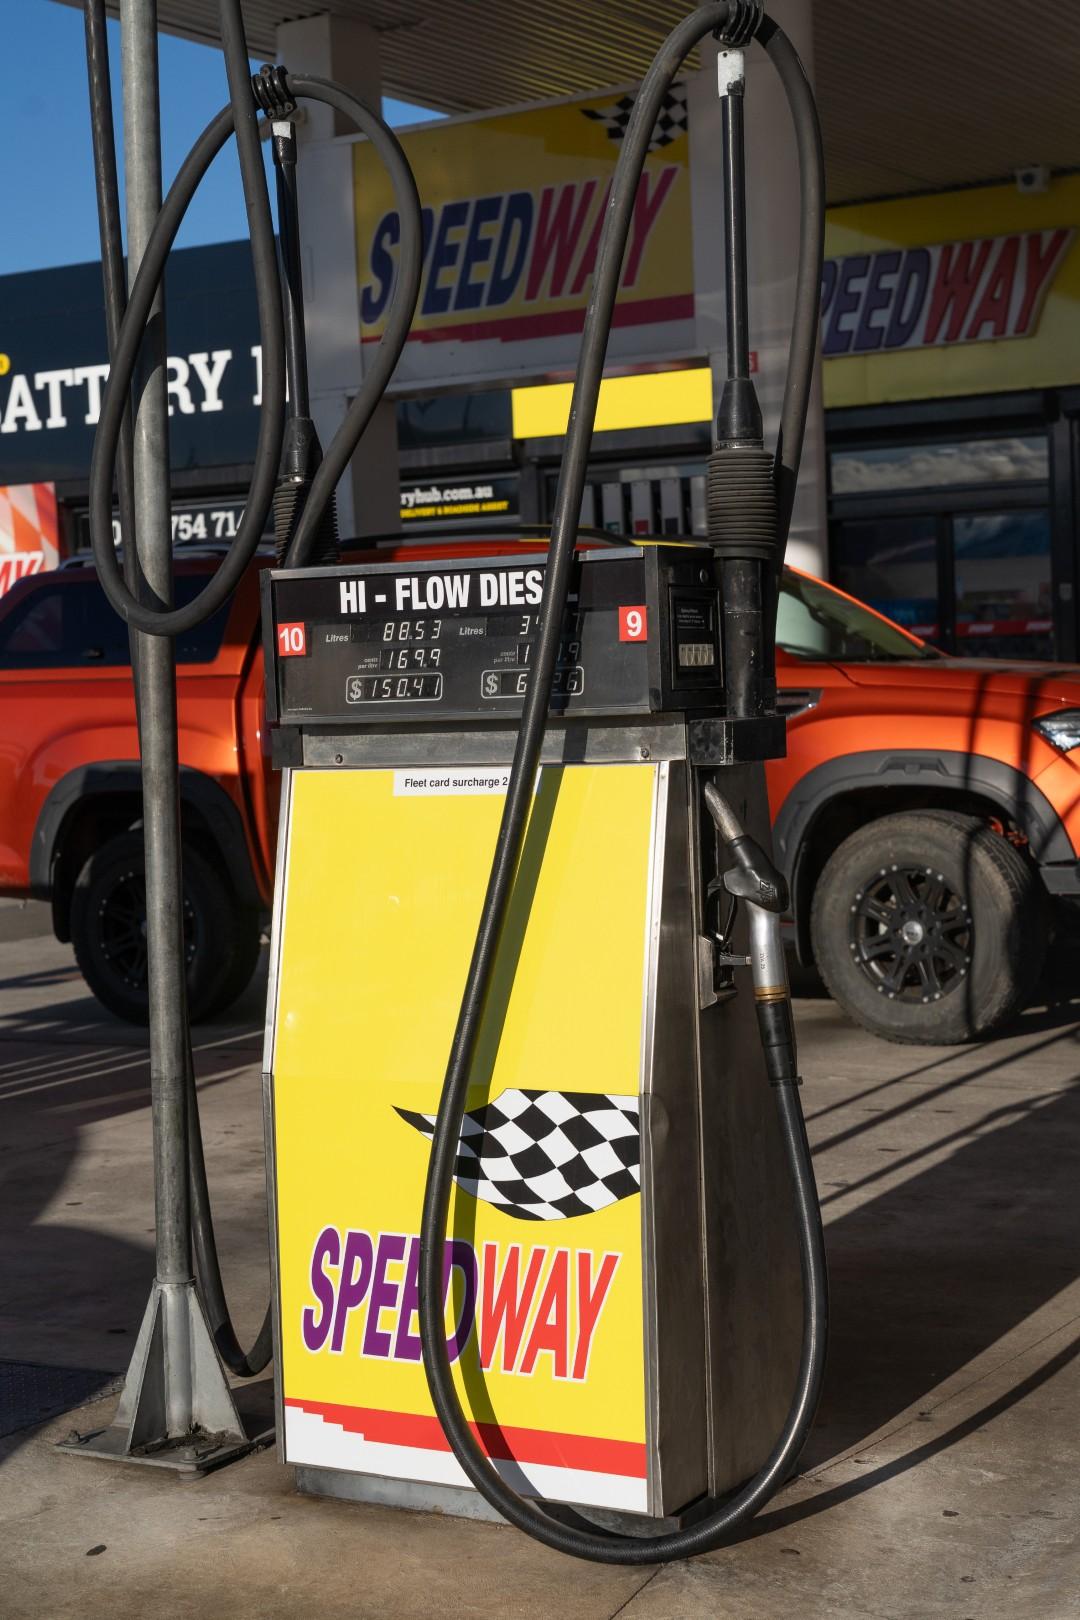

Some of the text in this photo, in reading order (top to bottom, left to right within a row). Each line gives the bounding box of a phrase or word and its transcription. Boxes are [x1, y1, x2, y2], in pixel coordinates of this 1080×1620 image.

[820, 227, 1070, 356] PEEDWAY
[0, 350, 232, 433] ATTRY
[340, 581, 366, 613] HI
[396, 575, 470, 610] FLOW
[480, 570, 546, 607] DIES
[325, 620, 441, 642] Litres 88.53
[459, 627, 484, 636] Litres
[627, 611, 643, 637] 9
[279, 627, 305, 652] 10
[388, 649, 440, 669] 169.9
[350, 677, 440, 700] $ 150.41
[485, 673, 498, 695] $
[405, 778, 427, 788] Fleet
[429, 778, 450, 787] card
[452, 777, 500, 789] surcharge
[302, 1226, 621, 1381] SPEEDWAY
